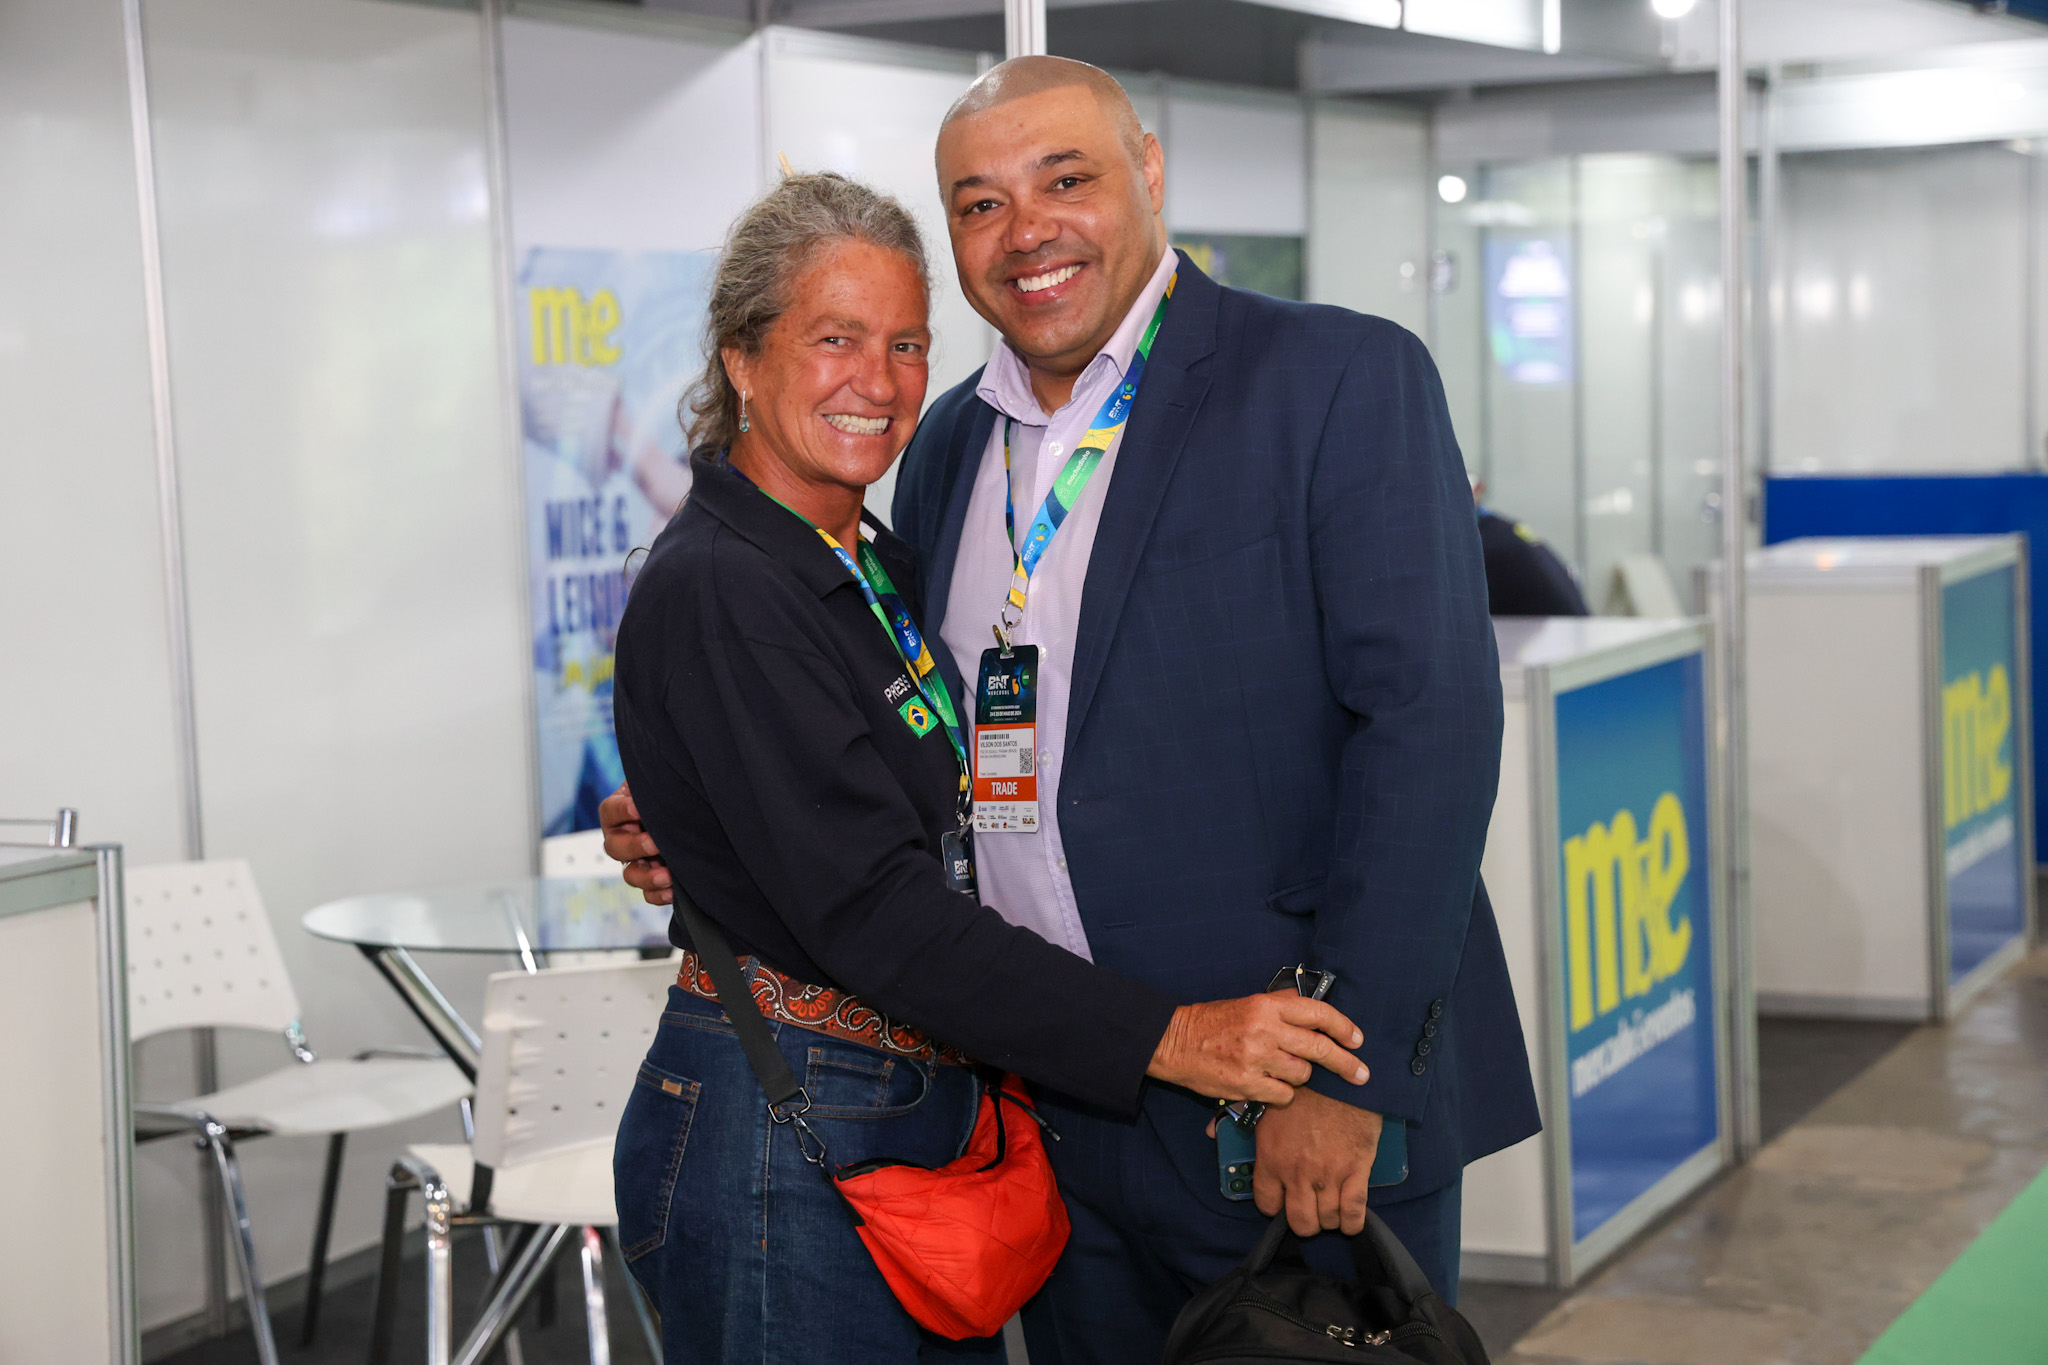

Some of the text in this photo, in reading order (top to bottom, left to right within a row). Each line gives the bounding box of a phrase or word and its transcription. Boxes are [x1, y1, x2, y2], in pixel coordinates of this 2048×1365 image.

[1107, 398, 1124, 420] BNT
[1066, 449, 1091, 486] machadinho
[883, 674, 911, 704] PRESS
[988, 675, 1010, 690] BNT
[991, 781, 1018, 795] TRADE
[953, 859, 969, 874] BNT
